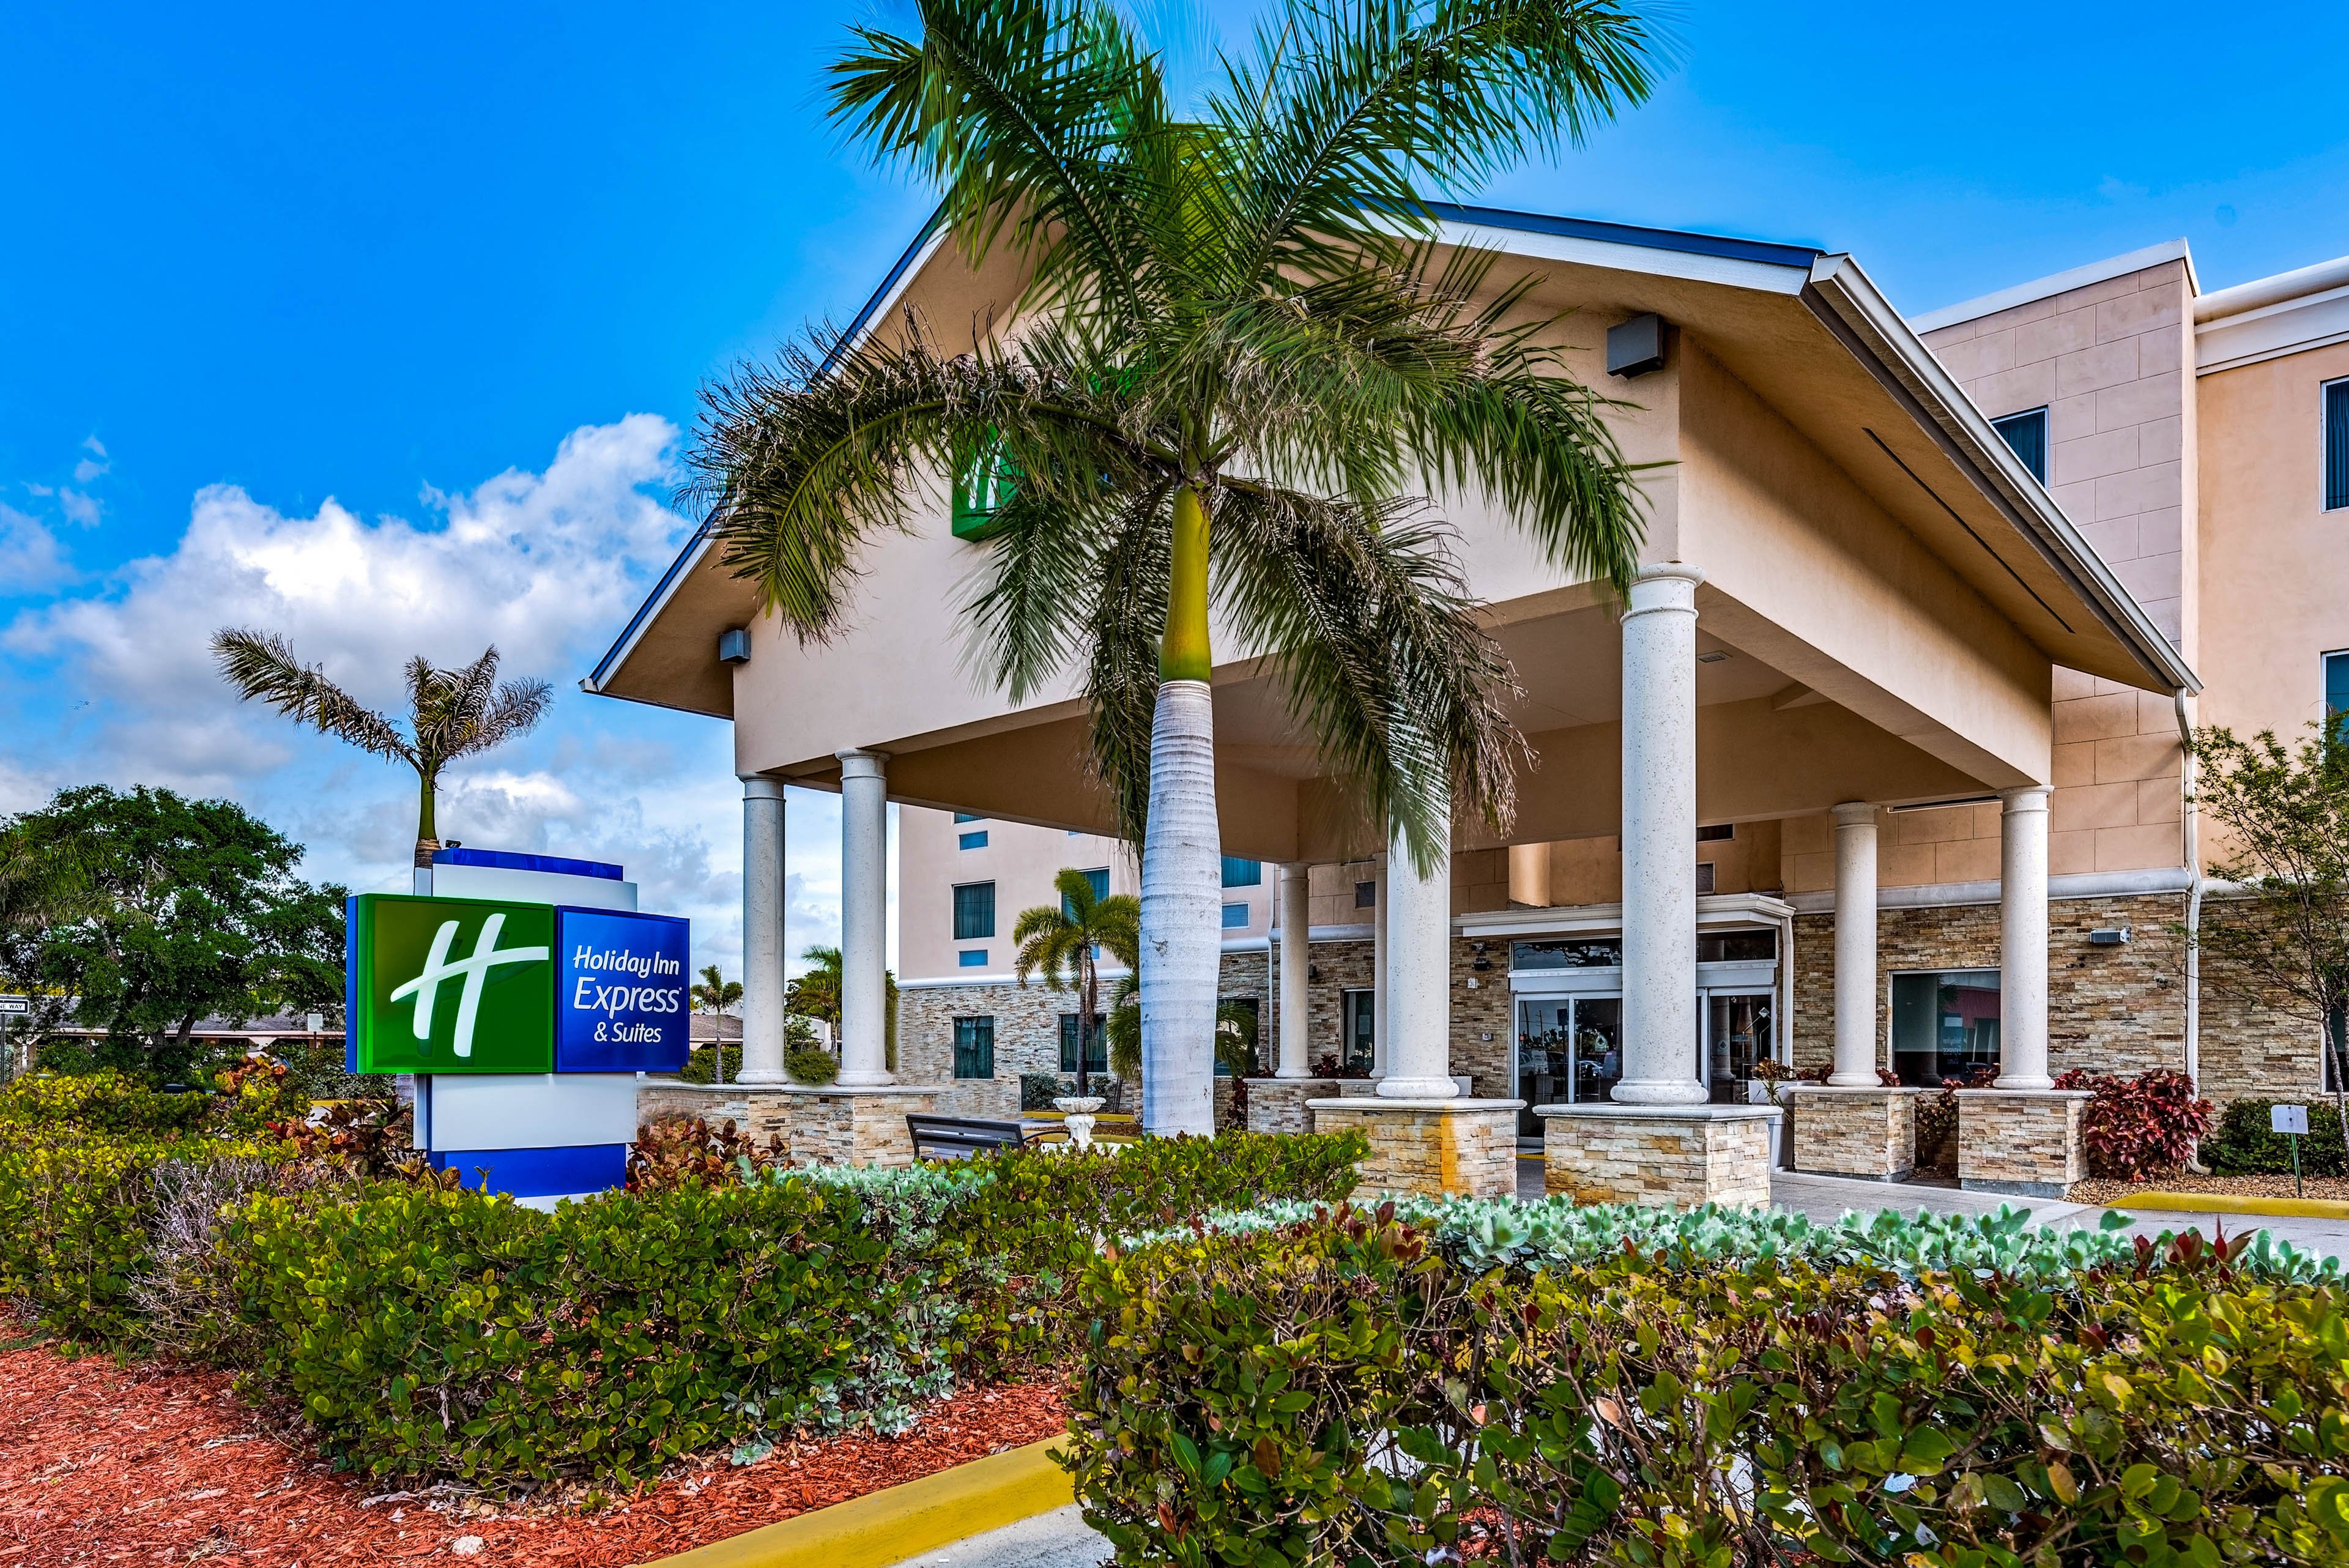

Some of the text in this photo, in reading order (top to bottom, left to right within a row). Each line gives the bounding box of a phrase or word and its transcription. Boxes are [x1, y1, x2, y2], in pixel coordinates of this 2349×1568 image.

[573, 945, 680, 978] Holiday Inn
[390, 912, 549, 1057] H
[574, 976, 680, 1019] Express
[594, 1022, 662, 1042] & Suites
